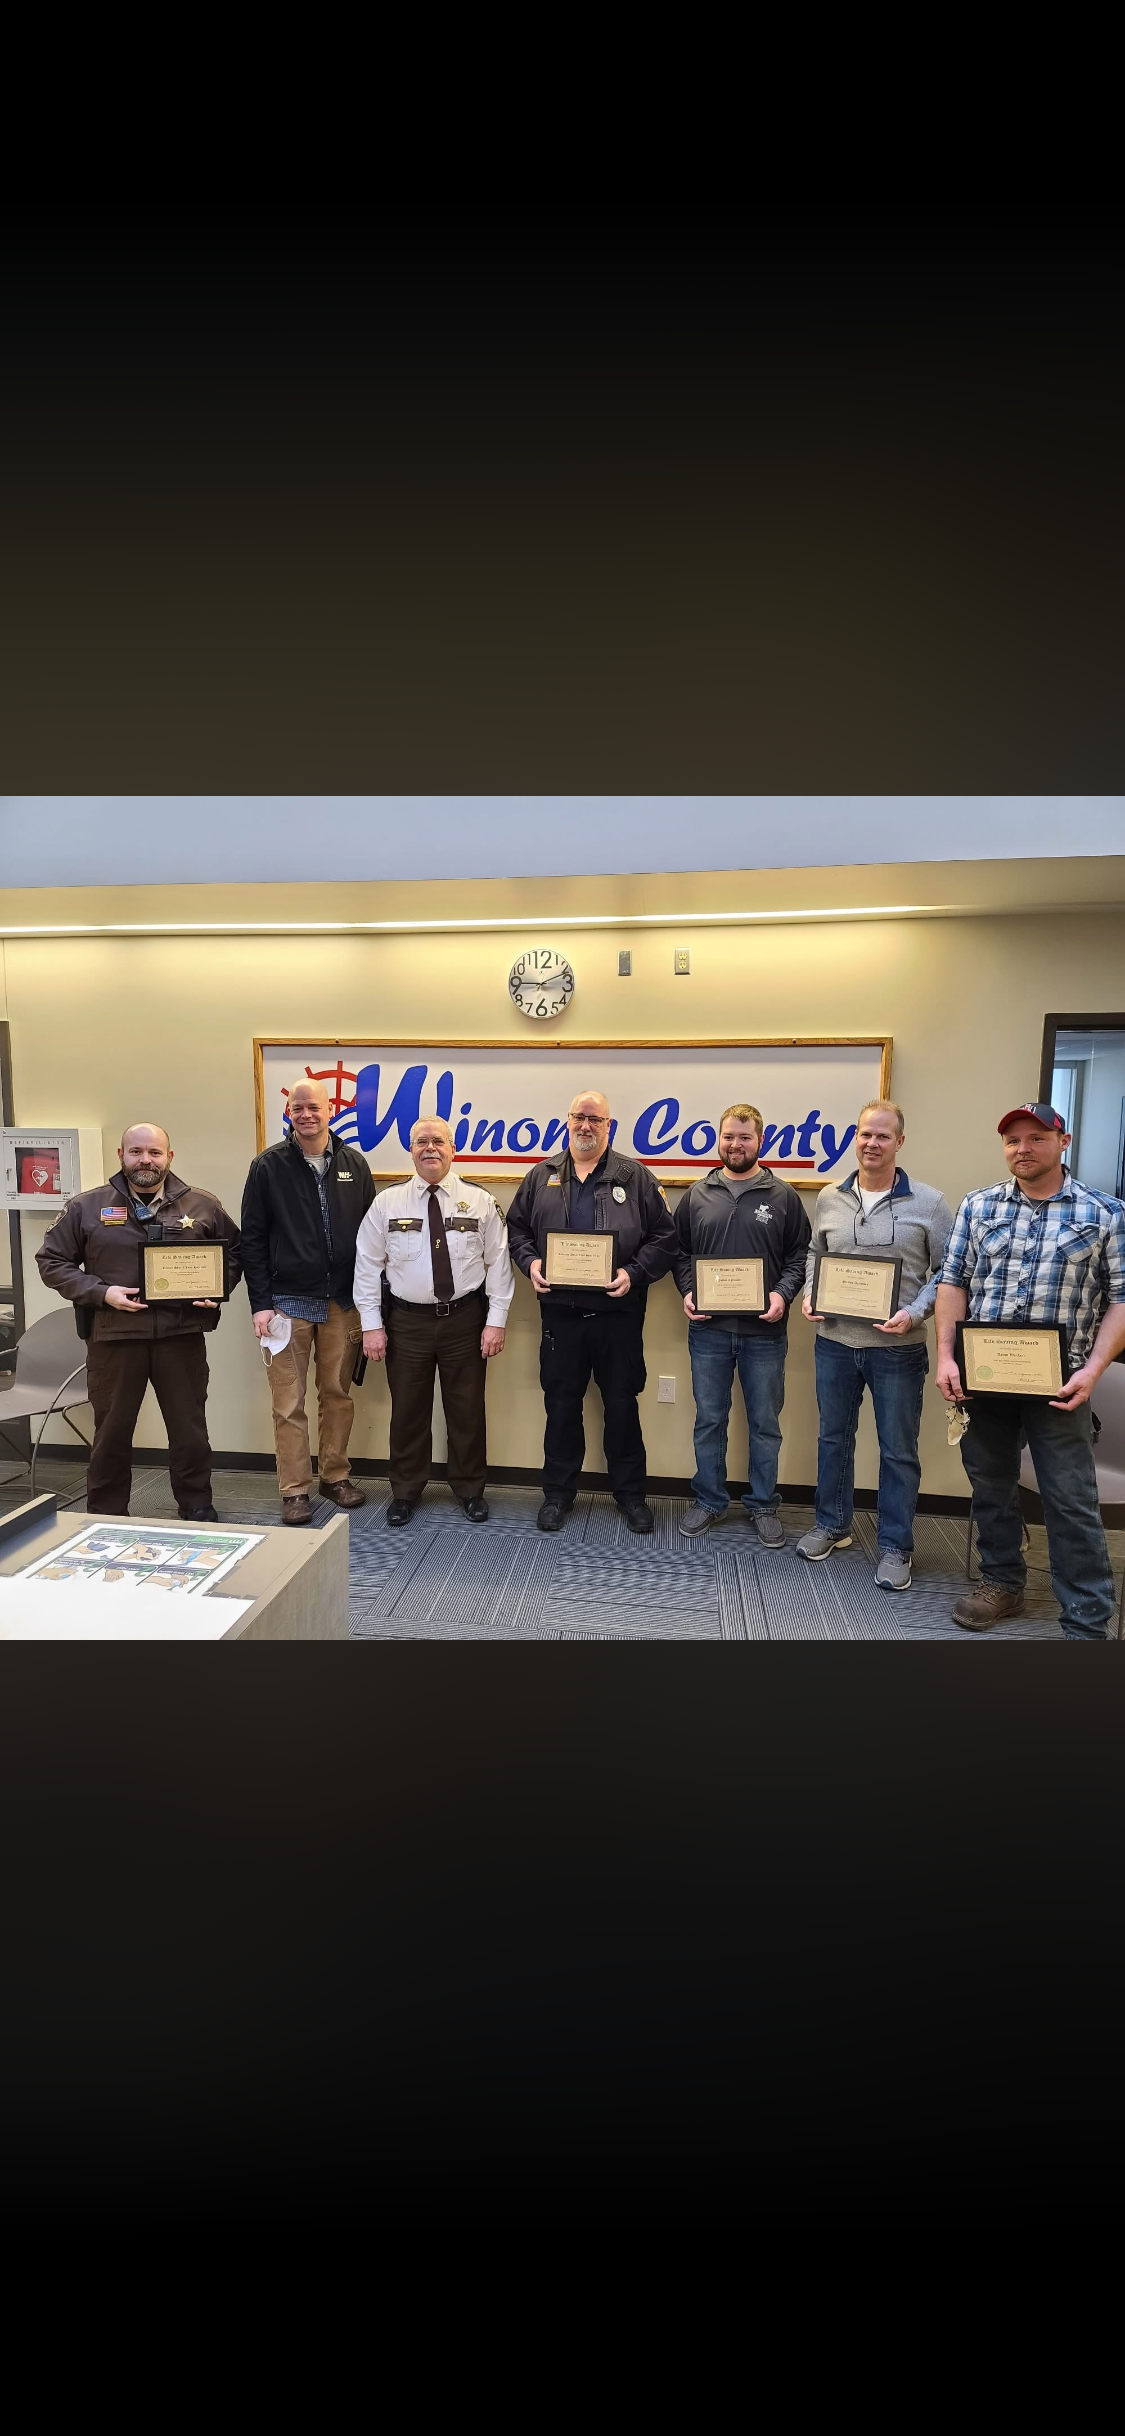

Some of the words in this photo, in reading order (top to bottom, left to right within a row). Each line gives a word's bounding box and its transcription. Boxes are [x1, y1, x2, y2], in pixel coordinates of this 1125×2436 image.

[532, 950, 552, 969] 12
[513, 962, 525, 975] 10
[561, 960, 570, 974] 2
[510, 975, 522, 995] 9
[561, 973, 573, 993] 3
[515, 993, 524, 1007] 8
[559, 992, 567, 1006] 4
[525, 1002, 534, 1014] 7
[535, 997, 548, 1017] 6
[550, 1001, 559, 1015] 5
[355, 1063, 619, 1153] Winon
[632, 1097, 858, 1173] Conty
